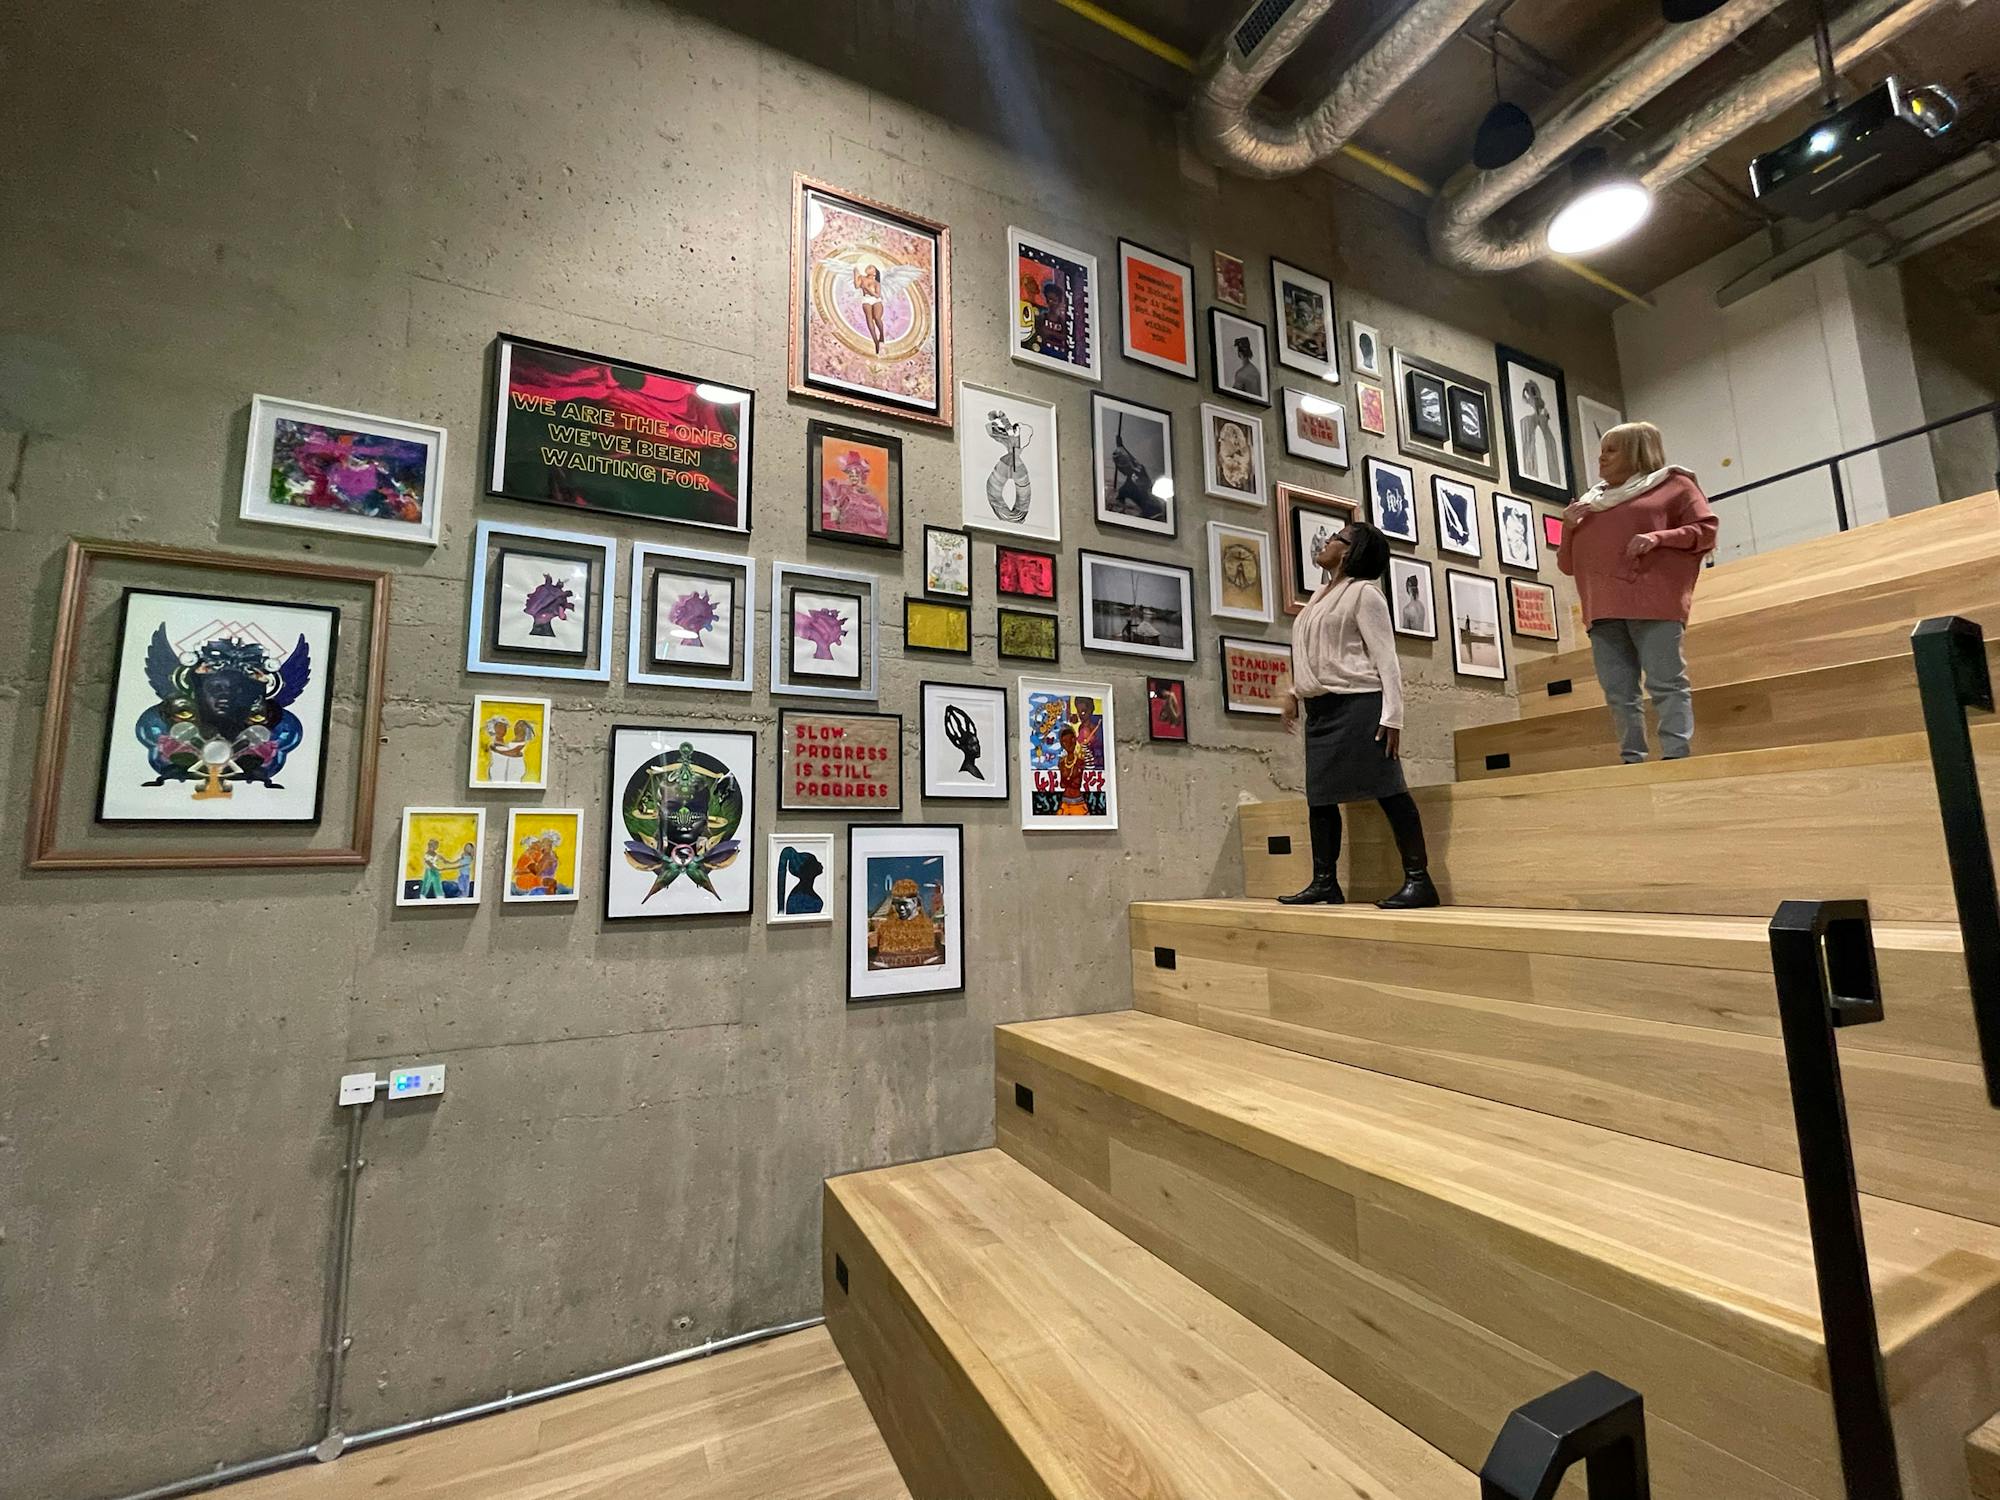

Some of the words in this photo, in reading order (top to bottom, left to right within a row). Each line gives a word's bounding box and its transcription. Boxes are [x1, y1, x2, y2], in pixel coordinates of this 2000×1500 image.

[512, 391, 556, 416] WE
[561, 402, 615, 428] ARE
[620, 413, 669, 438] THE
[674, 424, 737, 450] ONES
[548, 424, 631, 454] WE'VE
[636, 440, 700, 467] BEEN
[541, 447, 656, 483] WAITING
[661, 468, 710, 491] FOR
[1231, 669, 1277, 685] DESPITE
[1232, 684, 1243, 695] IT
[1248, 686, 1271, 699] ALL
[796, 724, 844, 740] SLOW
[796, 743, 888, 761] PROGRESS
[796, 762, 813, 777] IS
[822, 764, 872, 779] STILL
[796, 781, 888, 798] PROGRESS
